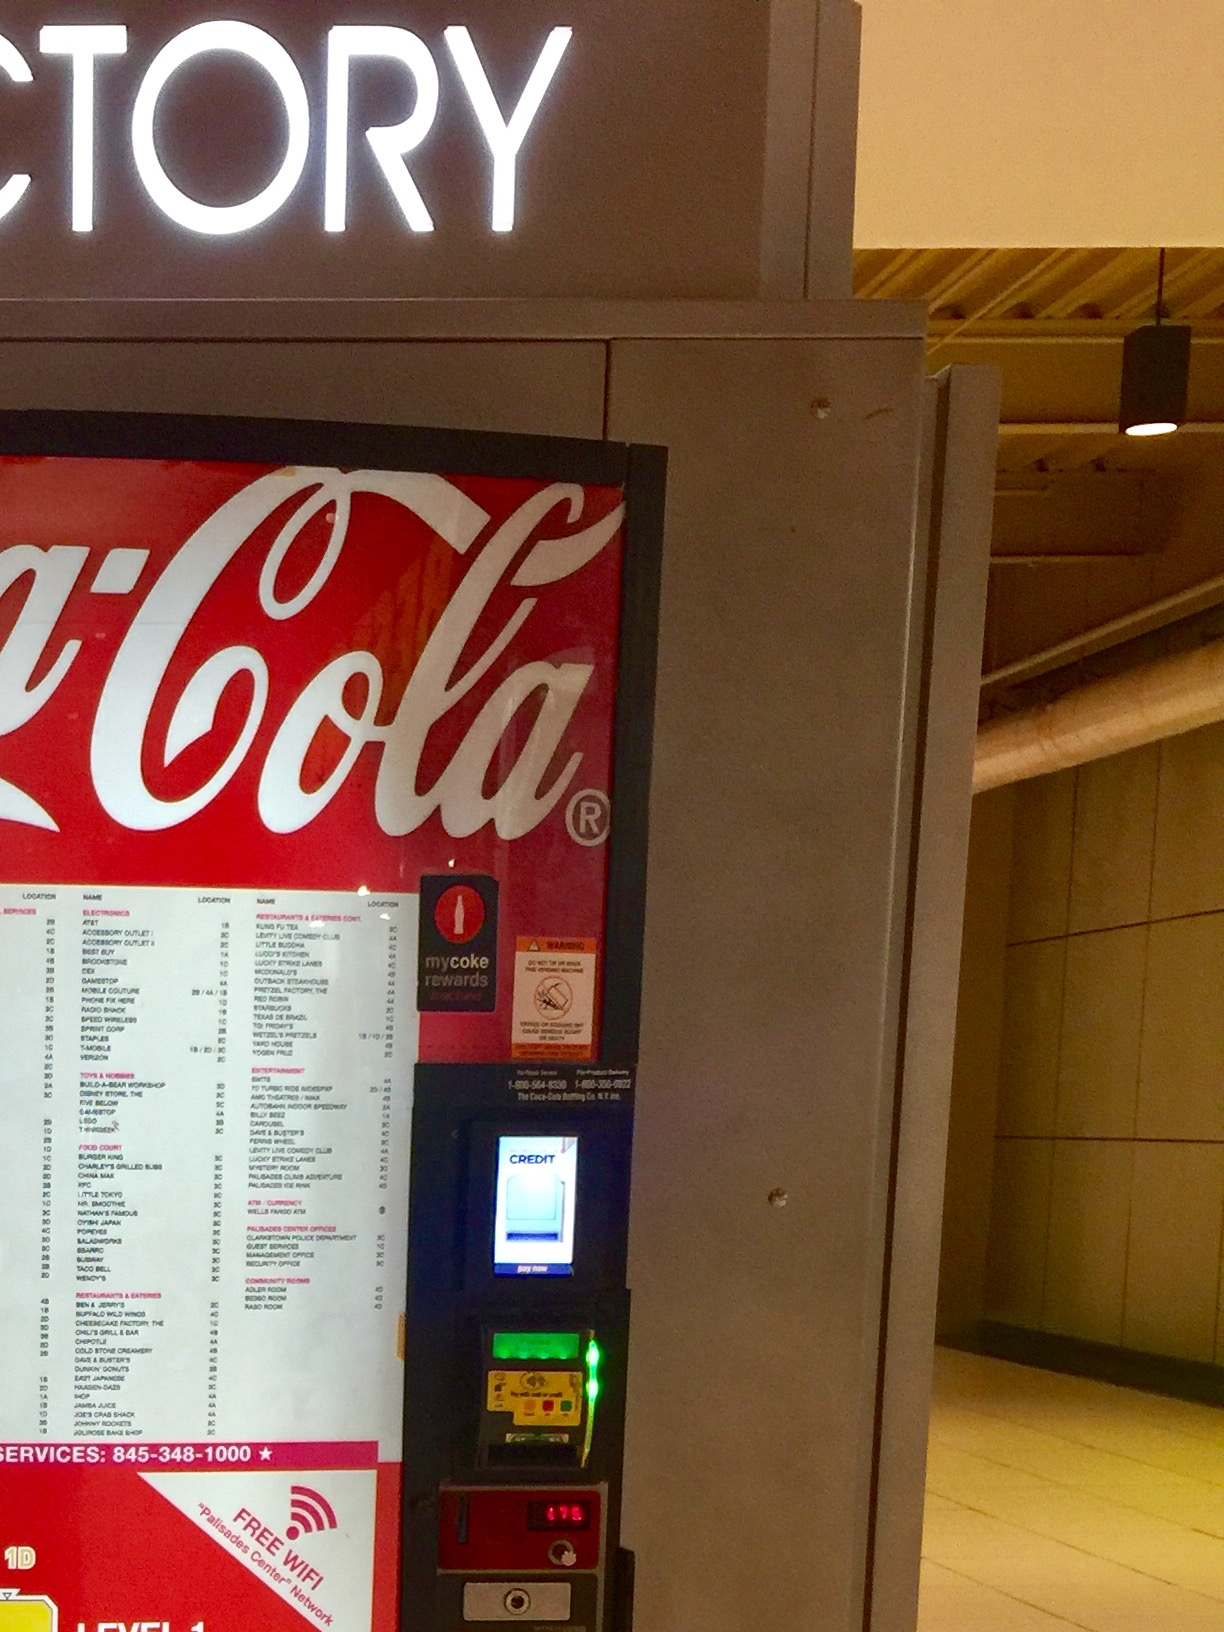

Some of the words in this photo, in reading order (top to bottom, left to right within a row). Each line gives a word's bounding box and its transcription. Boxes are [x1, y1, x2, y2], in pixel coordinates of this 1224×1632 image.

[426, 954, 489, 973] mycoke
[425, 972, 488, 988] rewards
[510, 1154, 556, 1164] CREDIT
[112, 1446, 251, 1463] 845-348-1000
[5, 1548, 35, 1569] 1D
[232, 1507, 285, 1557] FREE
[282, 1549, 324, 1591] WIFI
[289, 1584, 334, 1626] Network
